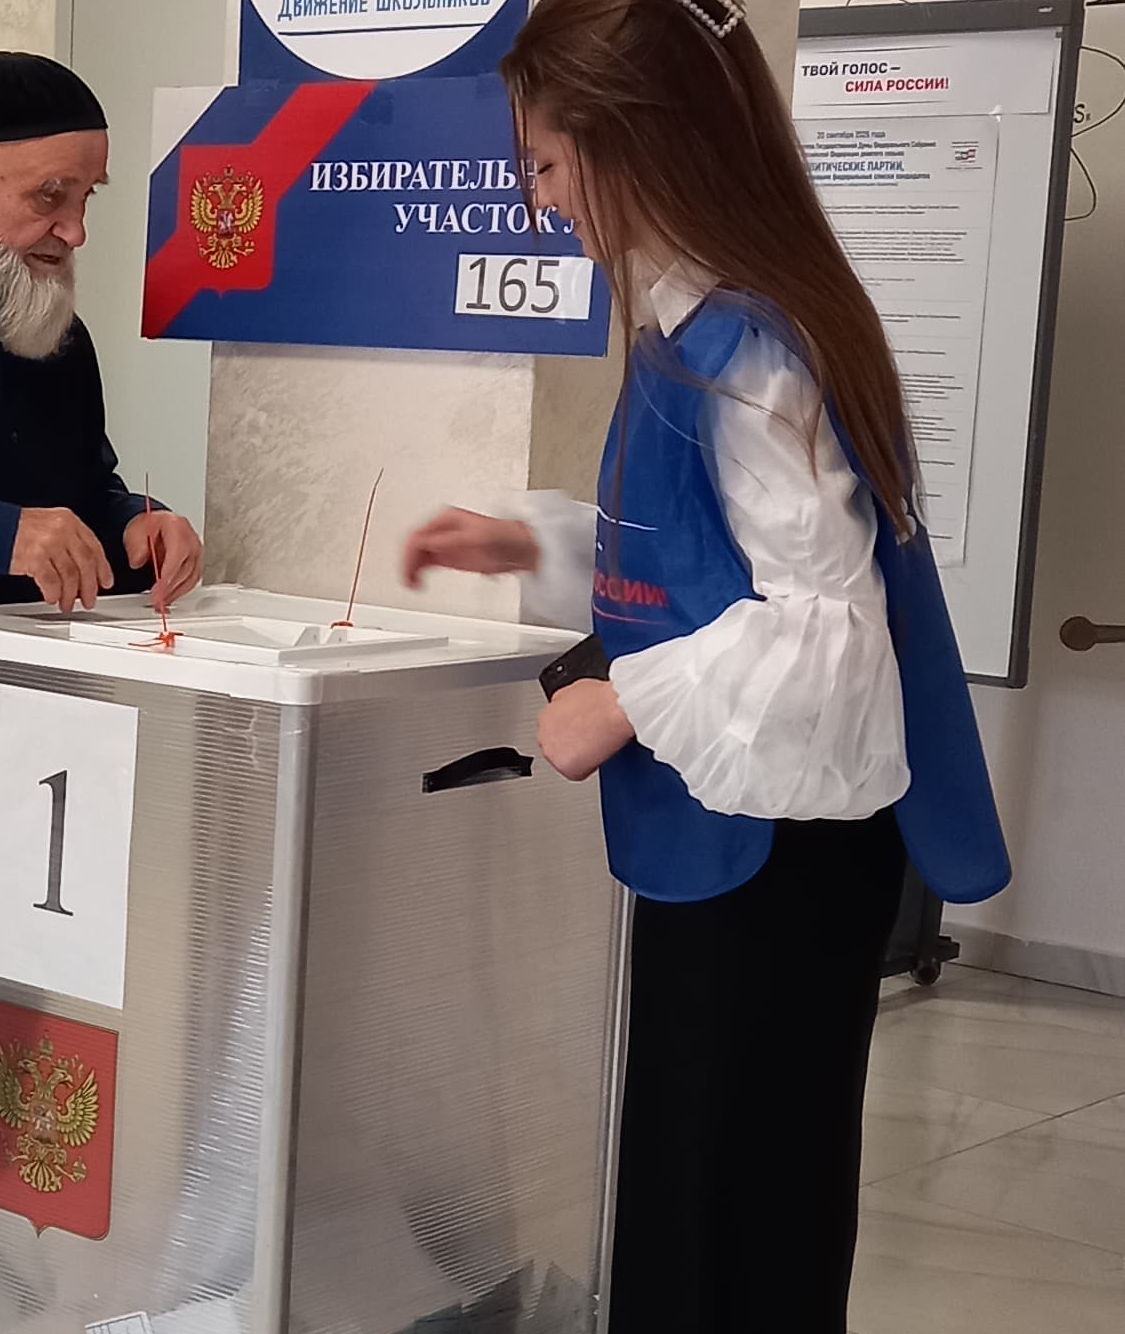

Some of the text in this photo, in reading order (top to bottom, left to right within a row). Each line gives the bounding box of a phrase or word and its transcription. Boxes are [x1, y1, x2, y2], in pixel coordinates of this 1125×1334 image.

[801, 61, 839, 77] ТВОЙ
[842, 62, 888, 76] ГОЛОС
[845, 77, 949, 93] СИЛА РОССИИ!
[394, 203, 557, 235] УЧАСТОК
[465, 257, 560, 314] 165
[33, 769, 74, 916] 1
